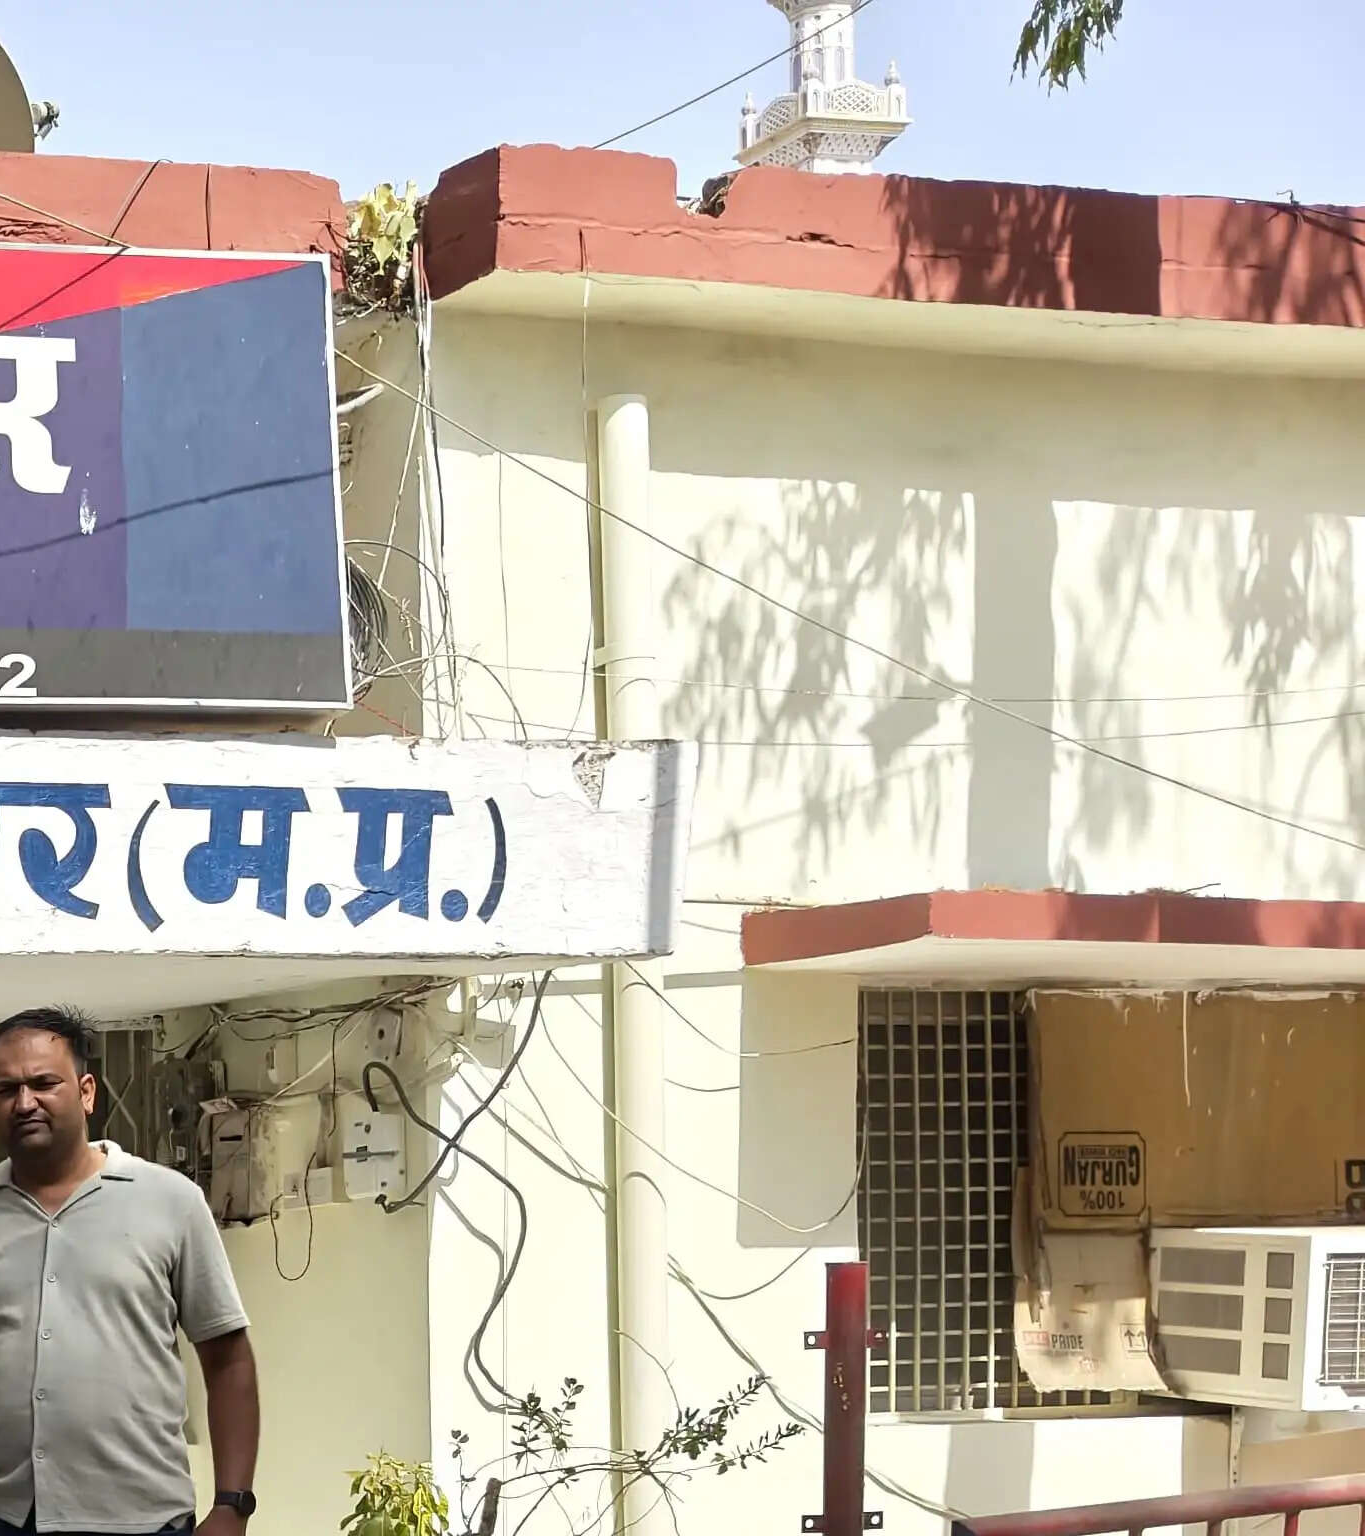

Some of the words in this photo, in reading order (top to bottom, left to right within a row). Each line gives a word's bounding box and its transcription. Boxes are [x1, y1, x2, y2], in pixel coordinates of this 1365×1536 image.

[126, 782, 509, 932] (म.प्र.)
[1063, 1145, 1141, 1187] GURJAN
[1079, 1190, 1126, 1210] 100%
[1051, 1334, 1084, 1350] PRIDE
